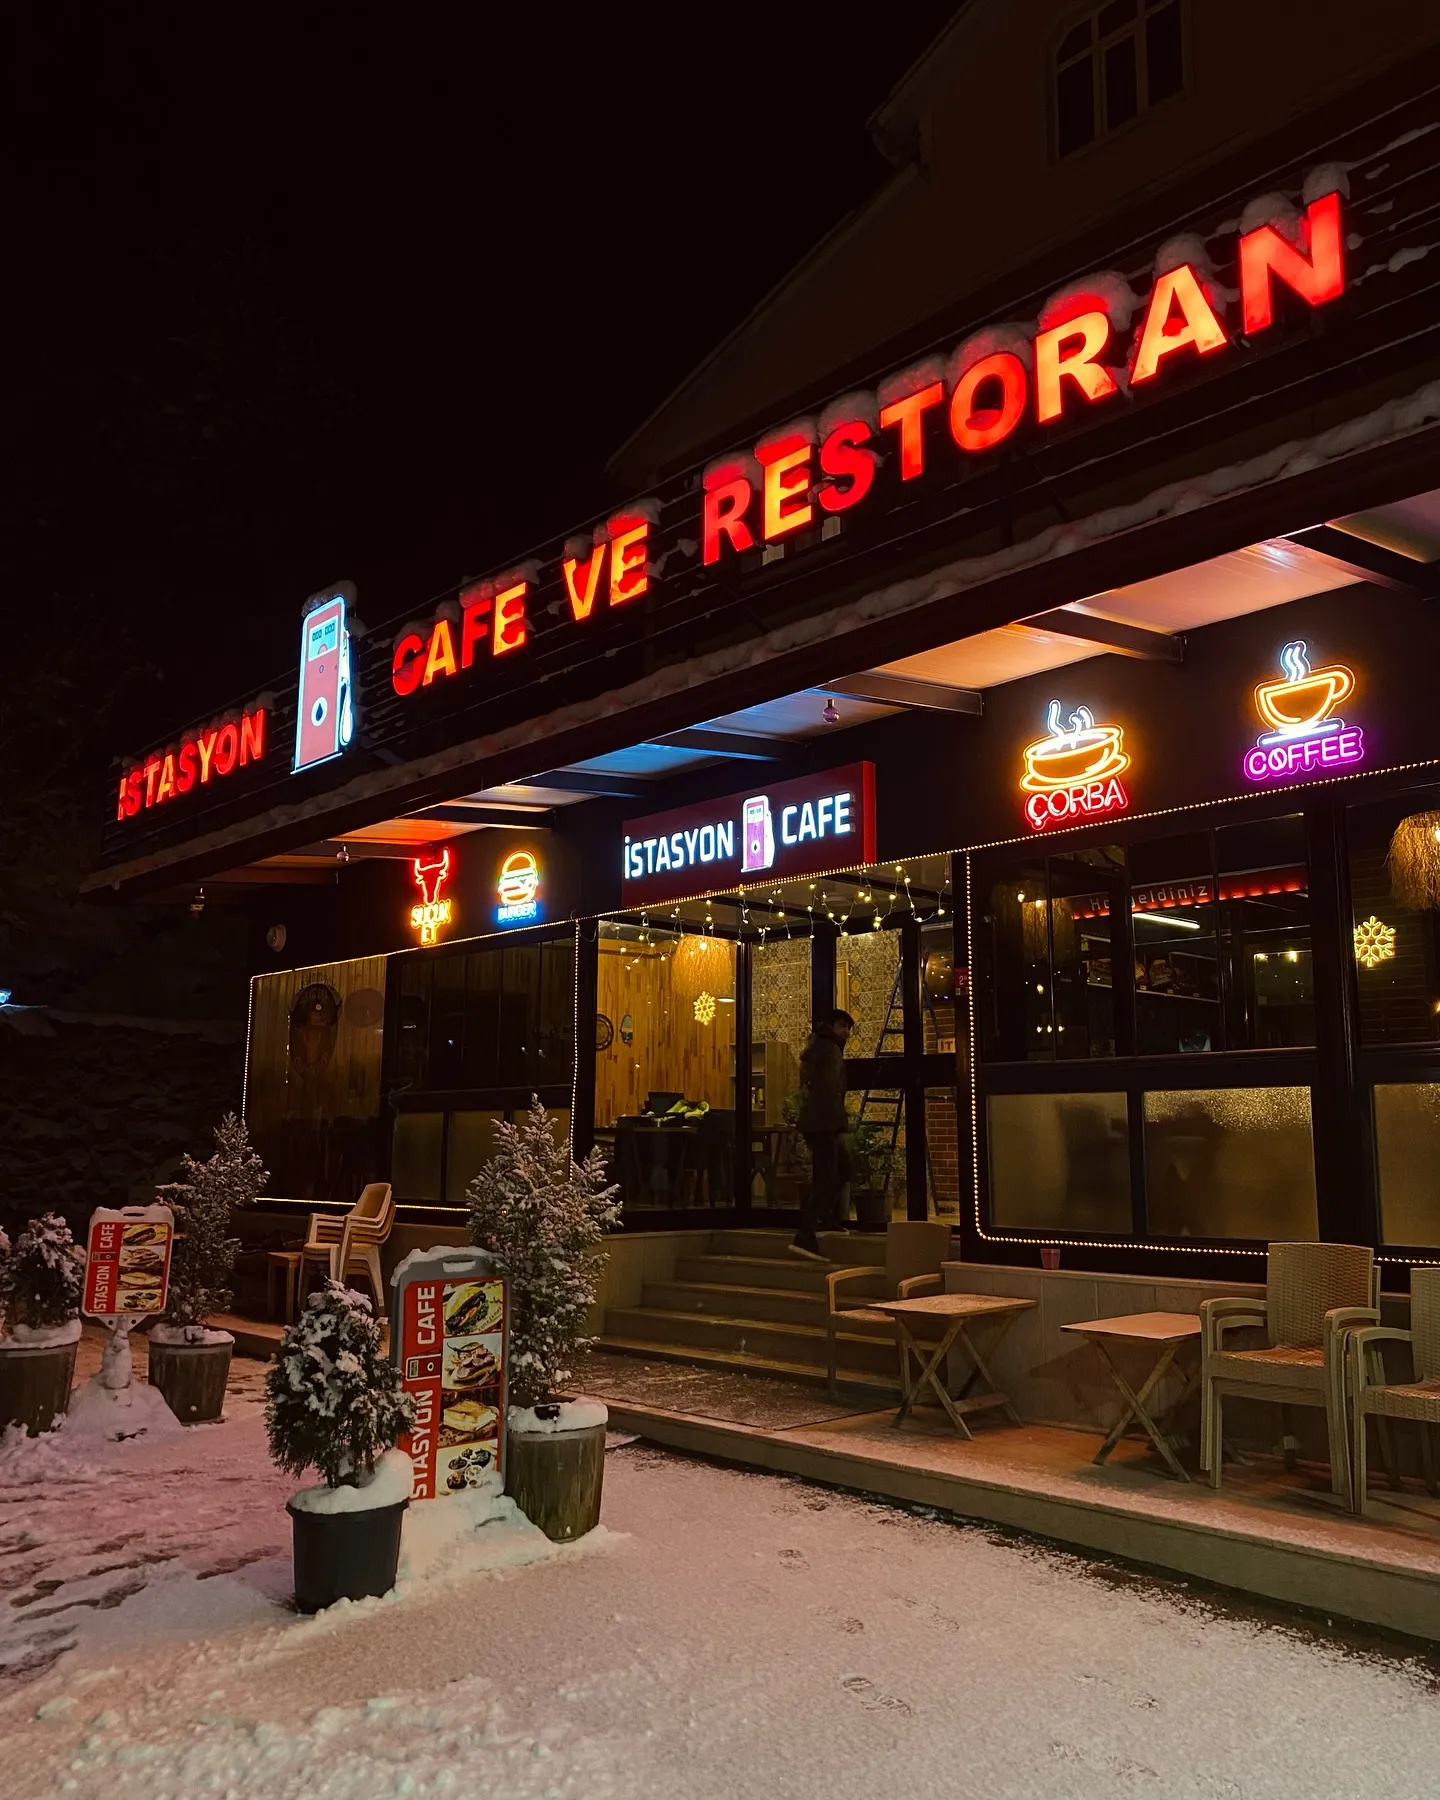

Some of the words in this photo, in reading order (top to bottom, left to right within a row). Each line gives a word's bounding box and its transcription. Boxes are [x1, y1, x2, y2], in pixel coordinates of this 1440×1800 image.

[392, 582, 527, 696] CAFE
[563, 523, 648, 620] VE
[702, 189, 1345, 566] RESTORAN
[1247, 731, 1360, 777] COFFEE
[781, 792, 851, 845] CAFE
[1026, 778, 1125, 826] ÇORBA
[411, 900, 451, 928] SUCUK
[421, 922, 437, 944] ET
[498, 902, 537, 922] BURGER
[100, 1224, 115, 1249] CAFE
[417, 1286, 435, 1345] CAFE
[408, 1389, 434, 1499] STASYON
